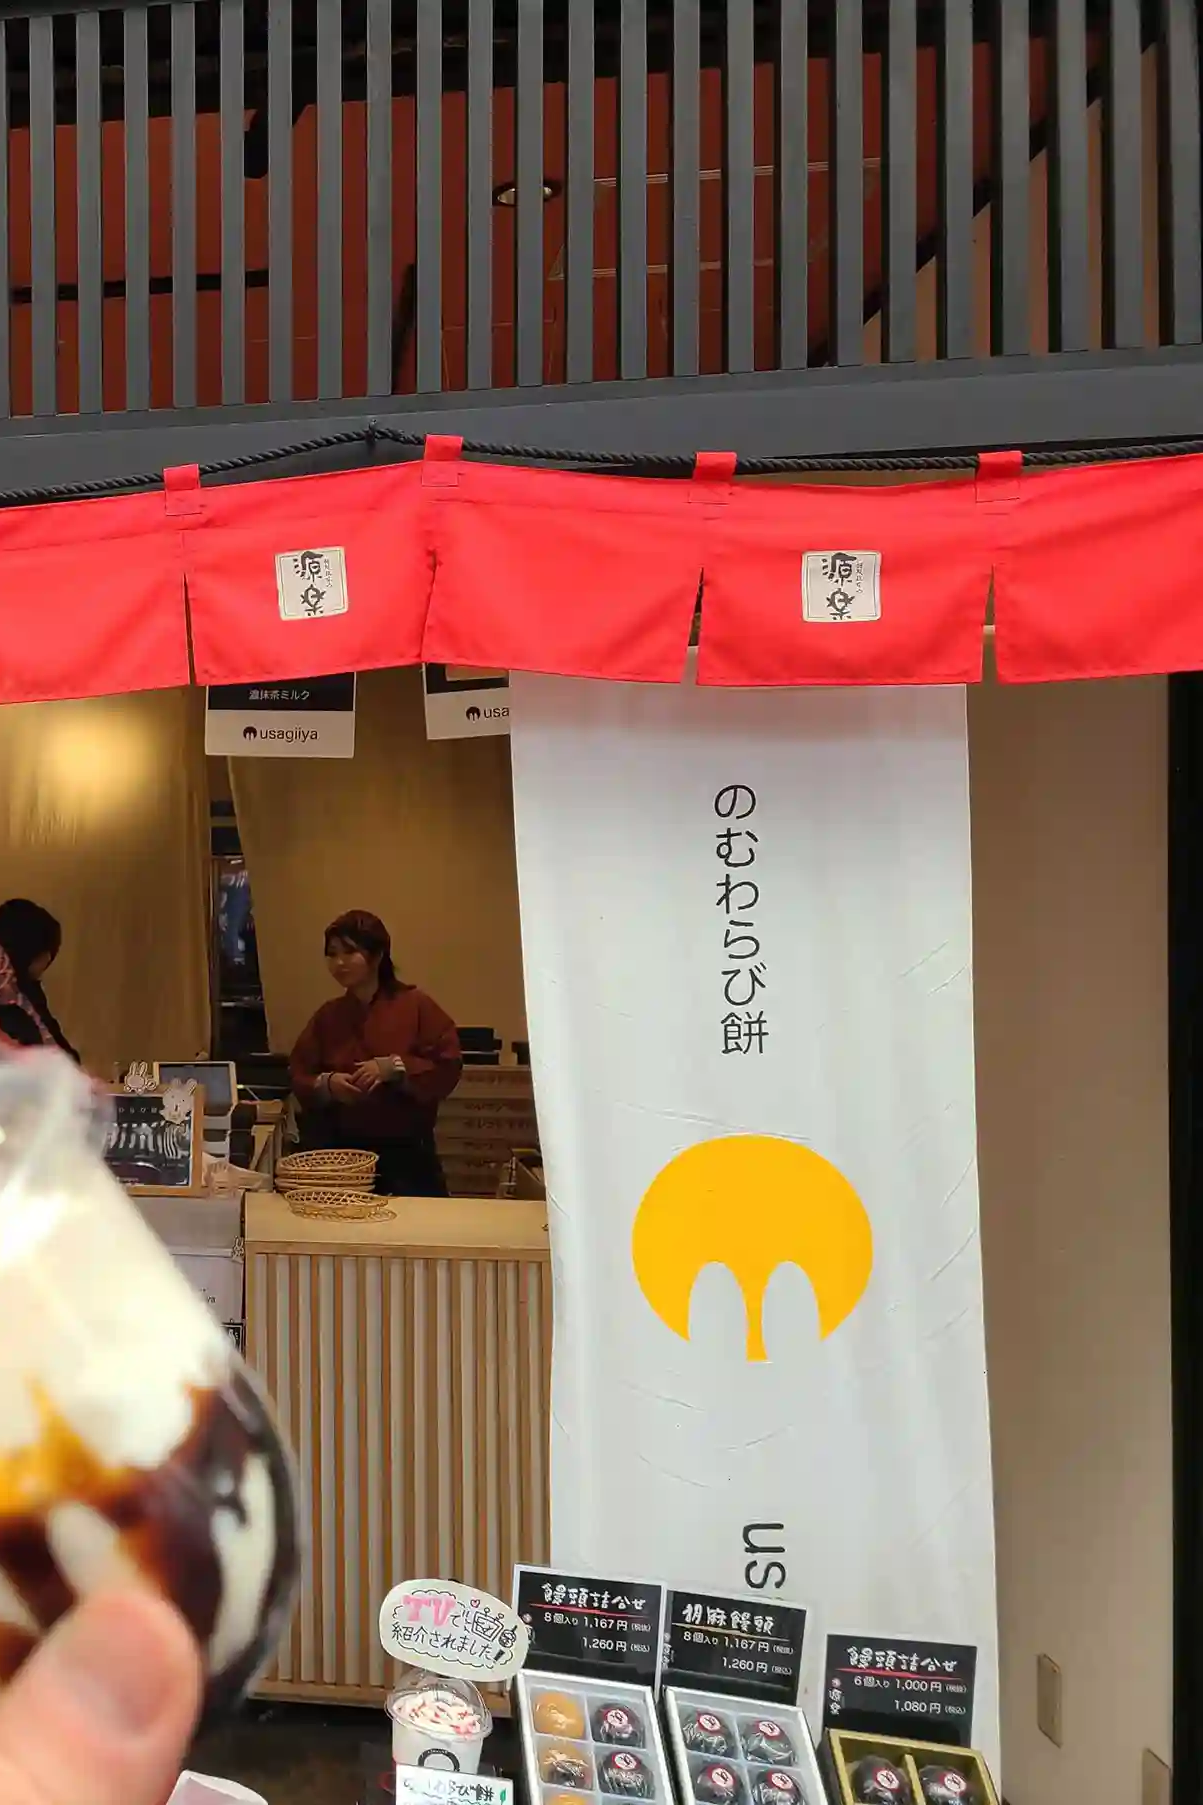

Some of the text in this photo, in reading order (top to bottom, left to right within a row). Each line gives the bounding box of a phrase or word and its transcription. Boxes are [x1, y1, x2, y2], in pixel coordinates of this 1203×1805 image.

[259, 726, 318, 743] usagiiya
[714, 784, 769, 1054] のむわらび餅
[742, 1523, 786, 1594] us
